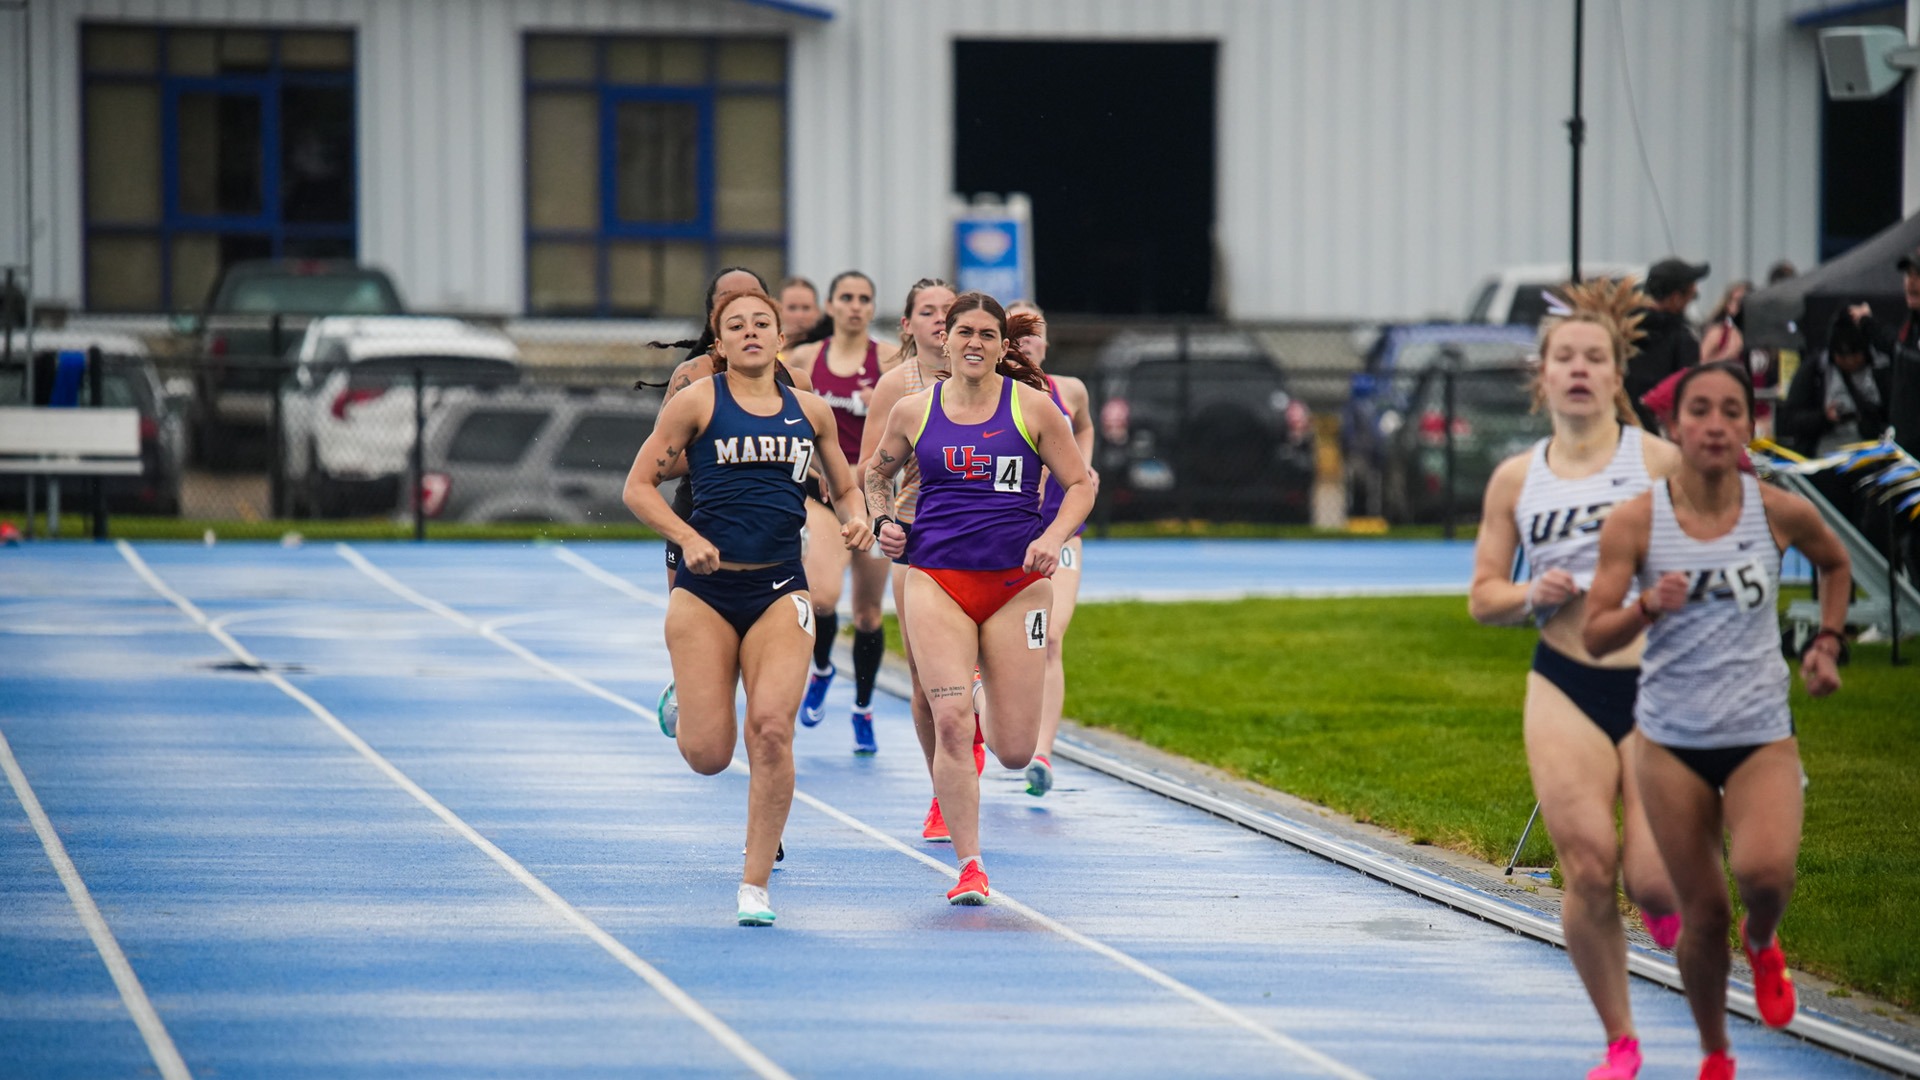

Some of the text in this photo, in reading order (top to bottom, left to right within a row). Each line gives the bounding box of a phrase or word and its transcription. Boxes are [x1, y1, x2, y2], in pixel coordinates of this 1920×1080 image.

[799, 444, 811, 481] 7
[942, 445, 992, 481] UE
[998, 458, 1018, 490] 4
[1736, 563, 1764, 609] 5
[797, 596, 809, 629] 7
[1031, 611, 1044, 647] 4
